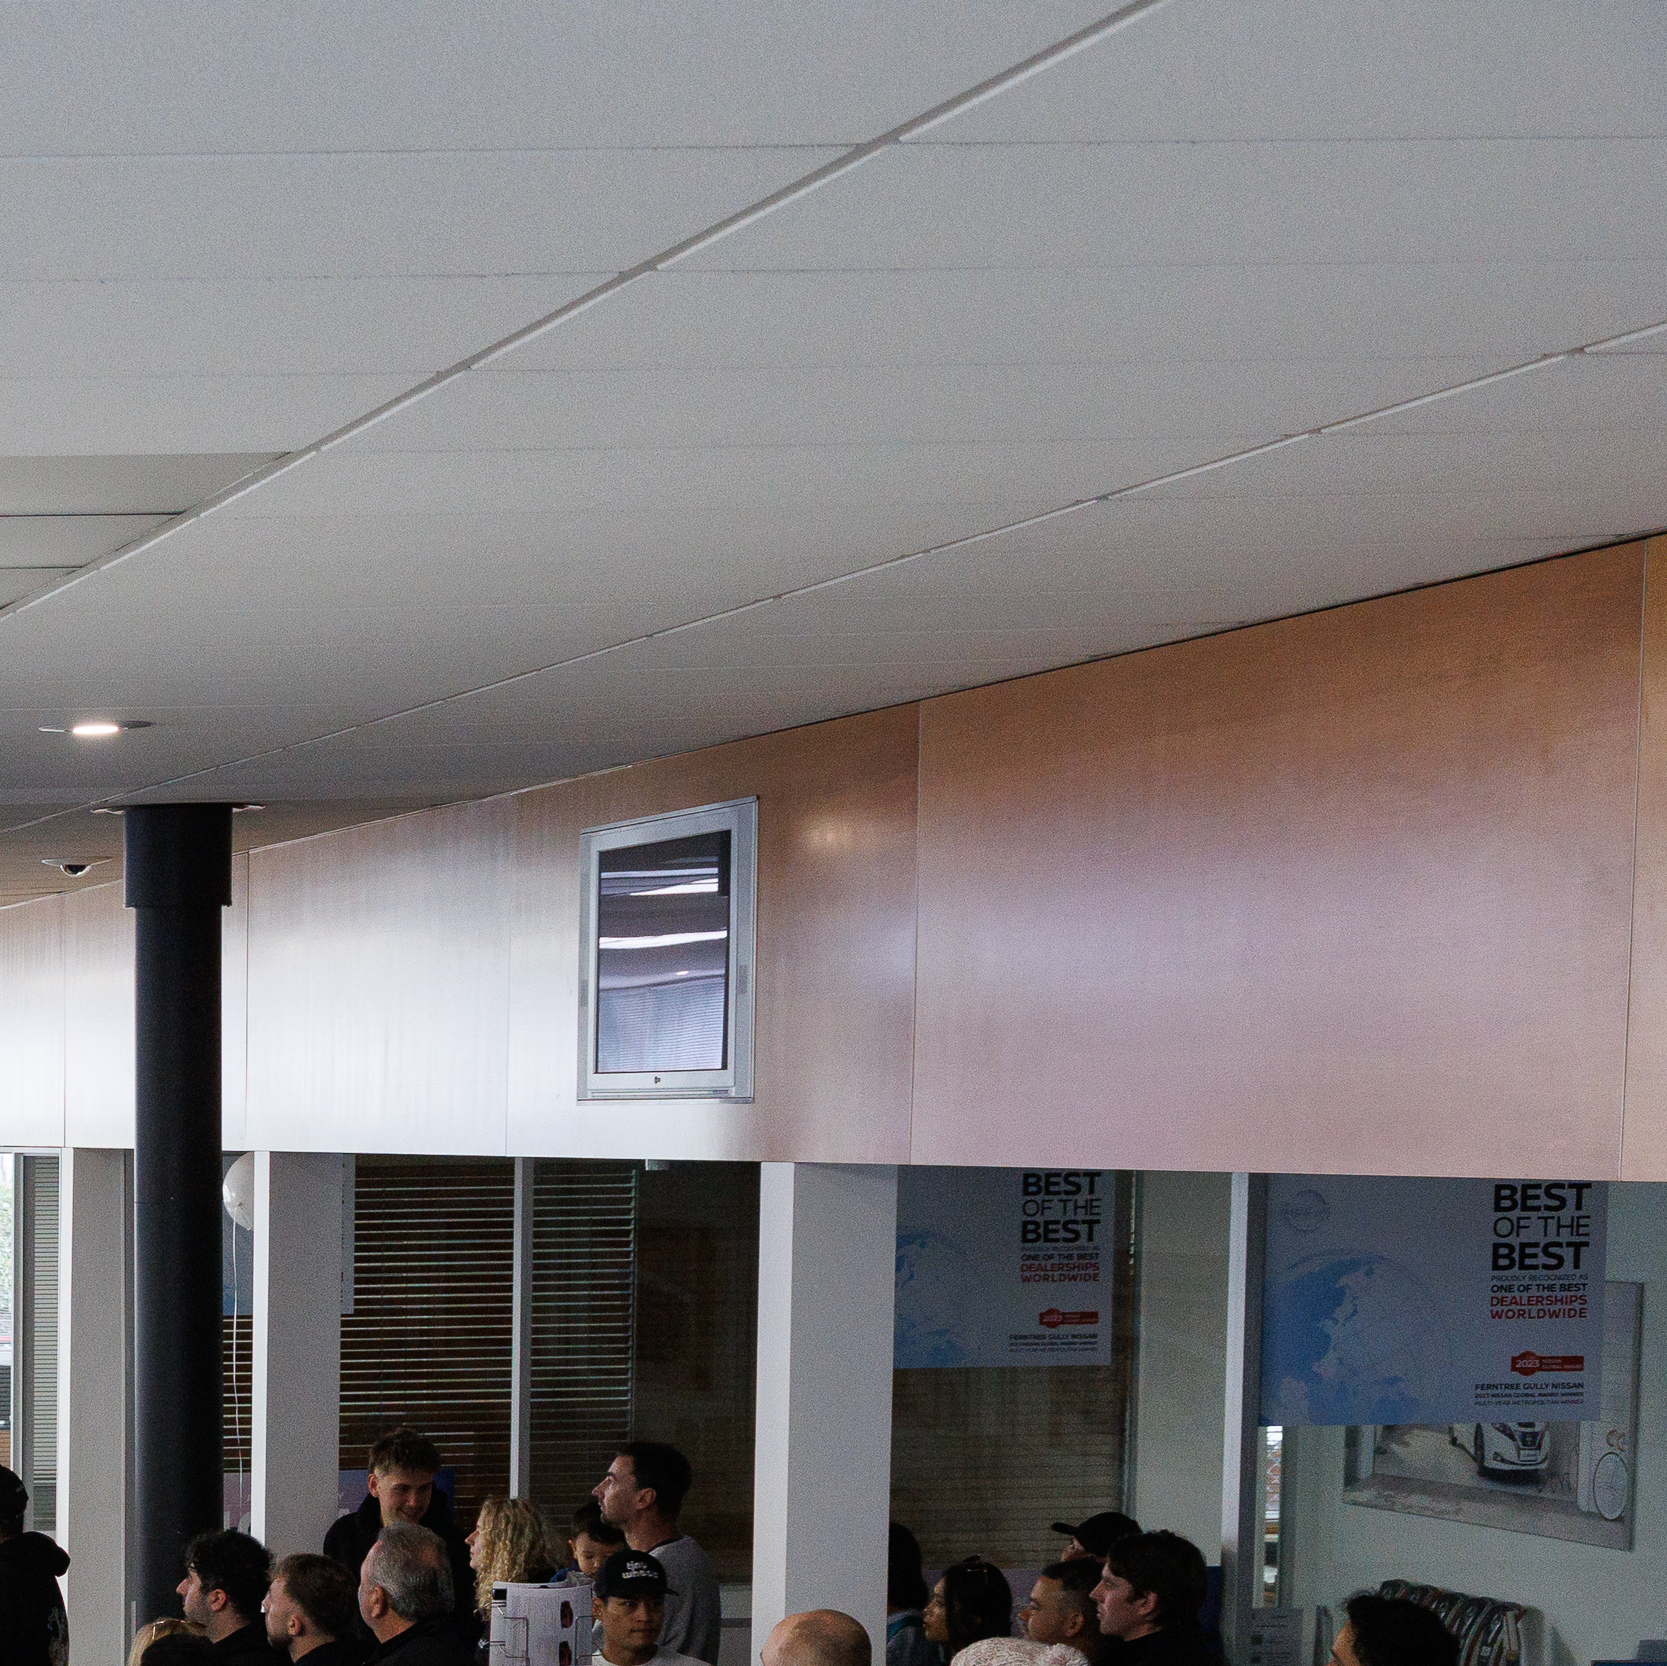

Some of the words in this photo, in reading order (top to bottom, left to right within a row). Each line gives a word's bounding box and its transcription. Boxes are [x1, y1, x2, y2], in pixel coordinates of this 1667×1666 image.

[1022, 1172, 1102, 1196] BEST
[1493, 1183, 1593, 1213] BEST
[1022, 1200, 1053, 1217] OF
[1058, 1198, 1102, 1216] THE
[1021, 1219, 1102, 1243] BEST
[1492, 1216, 1532, 1239] OF
[1537, 1215, 1592, 1238] THE
[1491, 1241, 1591, 1271] BEST
[1020, 1262, 1100, 1272] DEALERSHIPS
[1020, 1273, 1100, 1283] WORLDWIDE
[1490, 1284, 1516, 1293] ONE
[1516, 1284, 1533, 1293] OF
[1535, 1283, 1557, 1292] THE
[1559, 1283, 1588, 1292] BEST
[1490, 1294, 1588, 1307] DEALERSHIPS
[1490, 1308, 1588, 1320] WORLDWIDE
[1515, 1359, 1541, 1368] 2023
[1475, 1383, 1521, 1391] FERNTREE
[1522, 1382, 1549, 1390] GULLY
[1551, 1382, 1584, 1390] NISSAN
